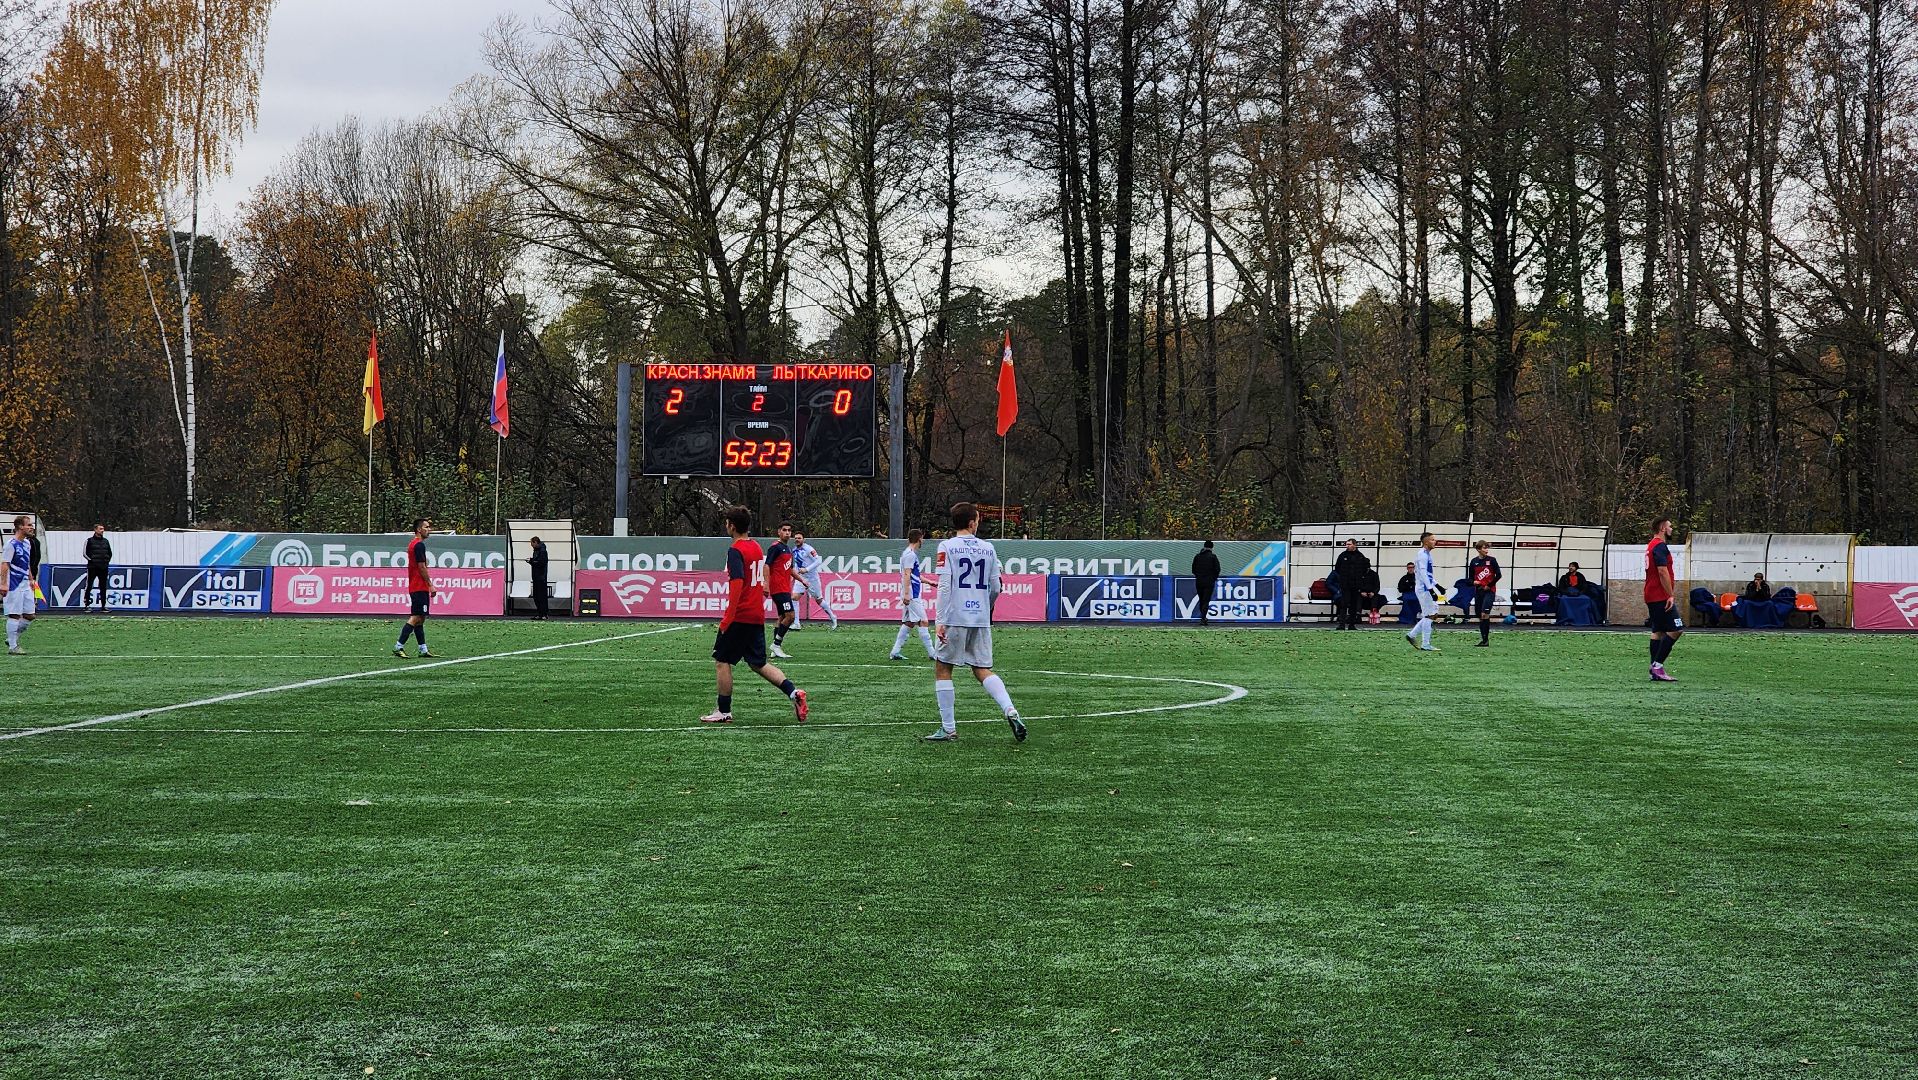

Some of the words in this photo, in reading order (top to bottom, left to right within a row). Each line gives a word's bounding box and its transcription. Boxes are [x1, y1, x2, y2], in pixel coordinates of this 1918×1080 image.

[648, 366, 755, 380] КРАСН.ЗНАМЯ
[773, 366, 872, 380] ЛЫТКАРИНО
[666, 389, 683, 414] 2
[752, 395, 764, 411] 2
[833, 389, 851, 414] 0
[587, 553, 700, 571] спорт
[1000, 558, 1169, 576] азвития
[749, 560, 764, 587] 14
[959, 557, 987, 590] 21
[332, 576, 393, 587] ПРЯМЫЕ
[661, 581, 729, 594] ЗНАМ
[196, 593, 258, 608] SPORT
[331, 592, 352, 603] на
[869, 598, 890, 609] на
[965, 600, 980, 609] GPS
[423, 604, 428, 613] 8
[1094, 602, 1156, 616] SPORT
[1207, 603, 1270, 617] SPORT
